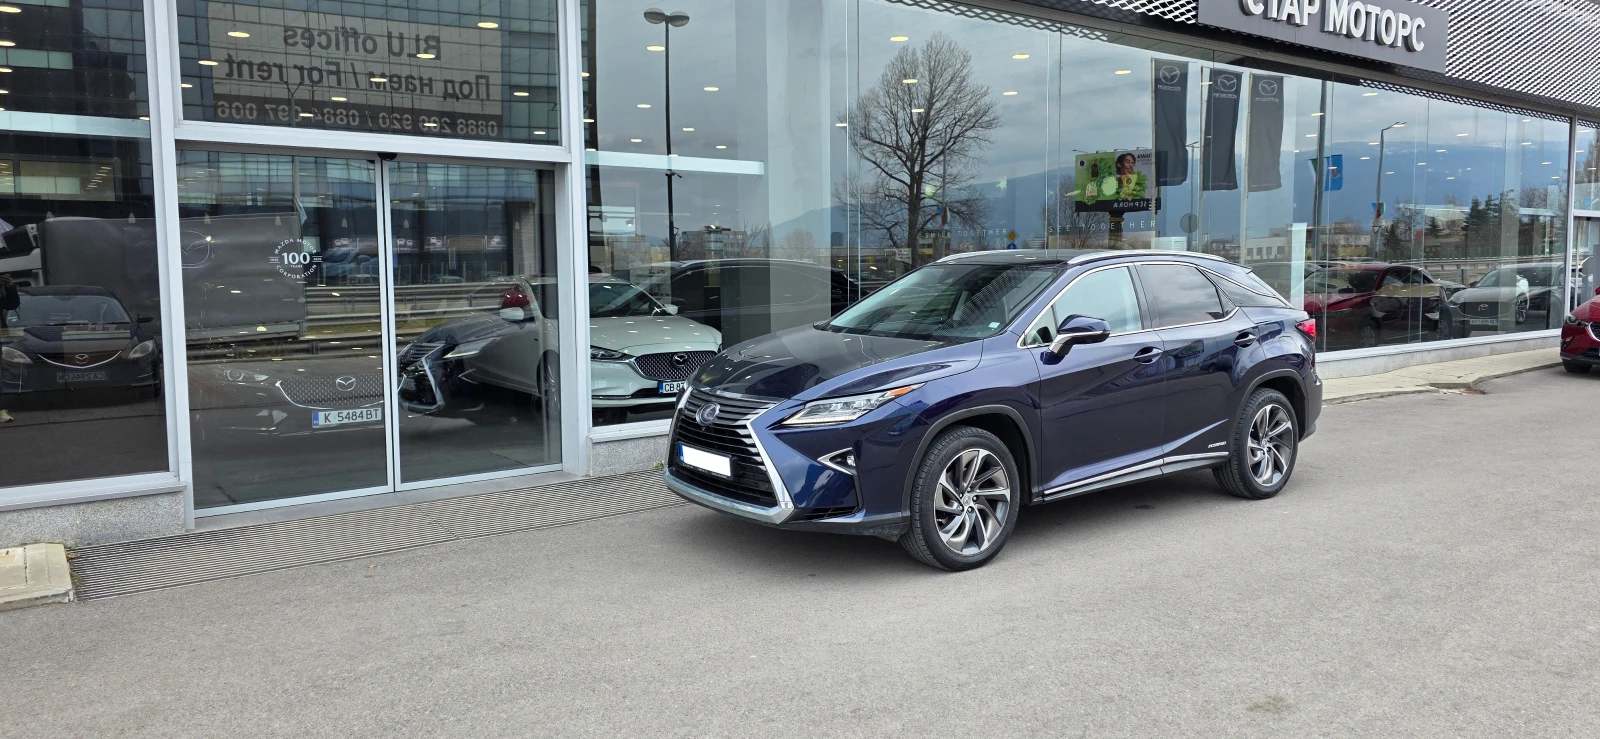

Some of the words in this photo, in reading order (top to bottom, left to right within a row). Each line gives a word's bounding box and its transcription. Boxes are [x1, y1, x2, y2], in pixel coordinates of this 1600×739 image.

[1323, 0, 1426, 51] МОТОРС
[274, 238, 294, 255] MAZDA
[296, 238, 317, 254] MOTOR
[281, 252, 310, 265] 100
[276, 264, 317, 279] CORPORATION
[324, 412, 332, 423] K
